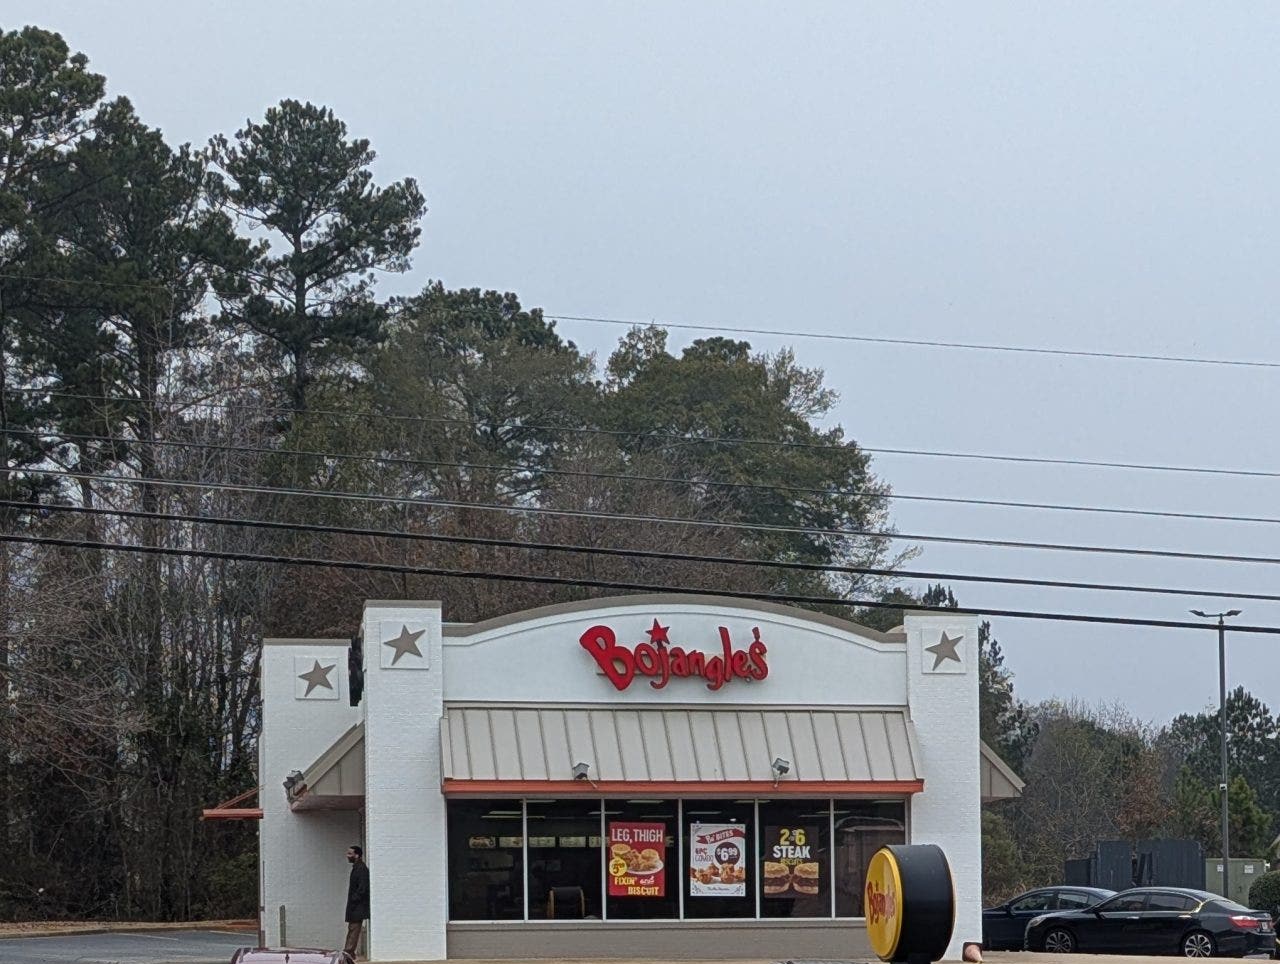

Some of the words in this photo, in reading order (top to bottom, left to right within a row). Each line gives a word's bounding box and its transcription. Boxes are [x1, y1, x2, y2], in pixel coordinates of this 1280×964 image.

[611, 828, 632, 844] LEG,
[633, 829, 663, 843] THIGH
[780, 828, 790, 845] 2
[772, 845, 811, 859] STEAK
[628, 886, 660, 896] BISCUIT
